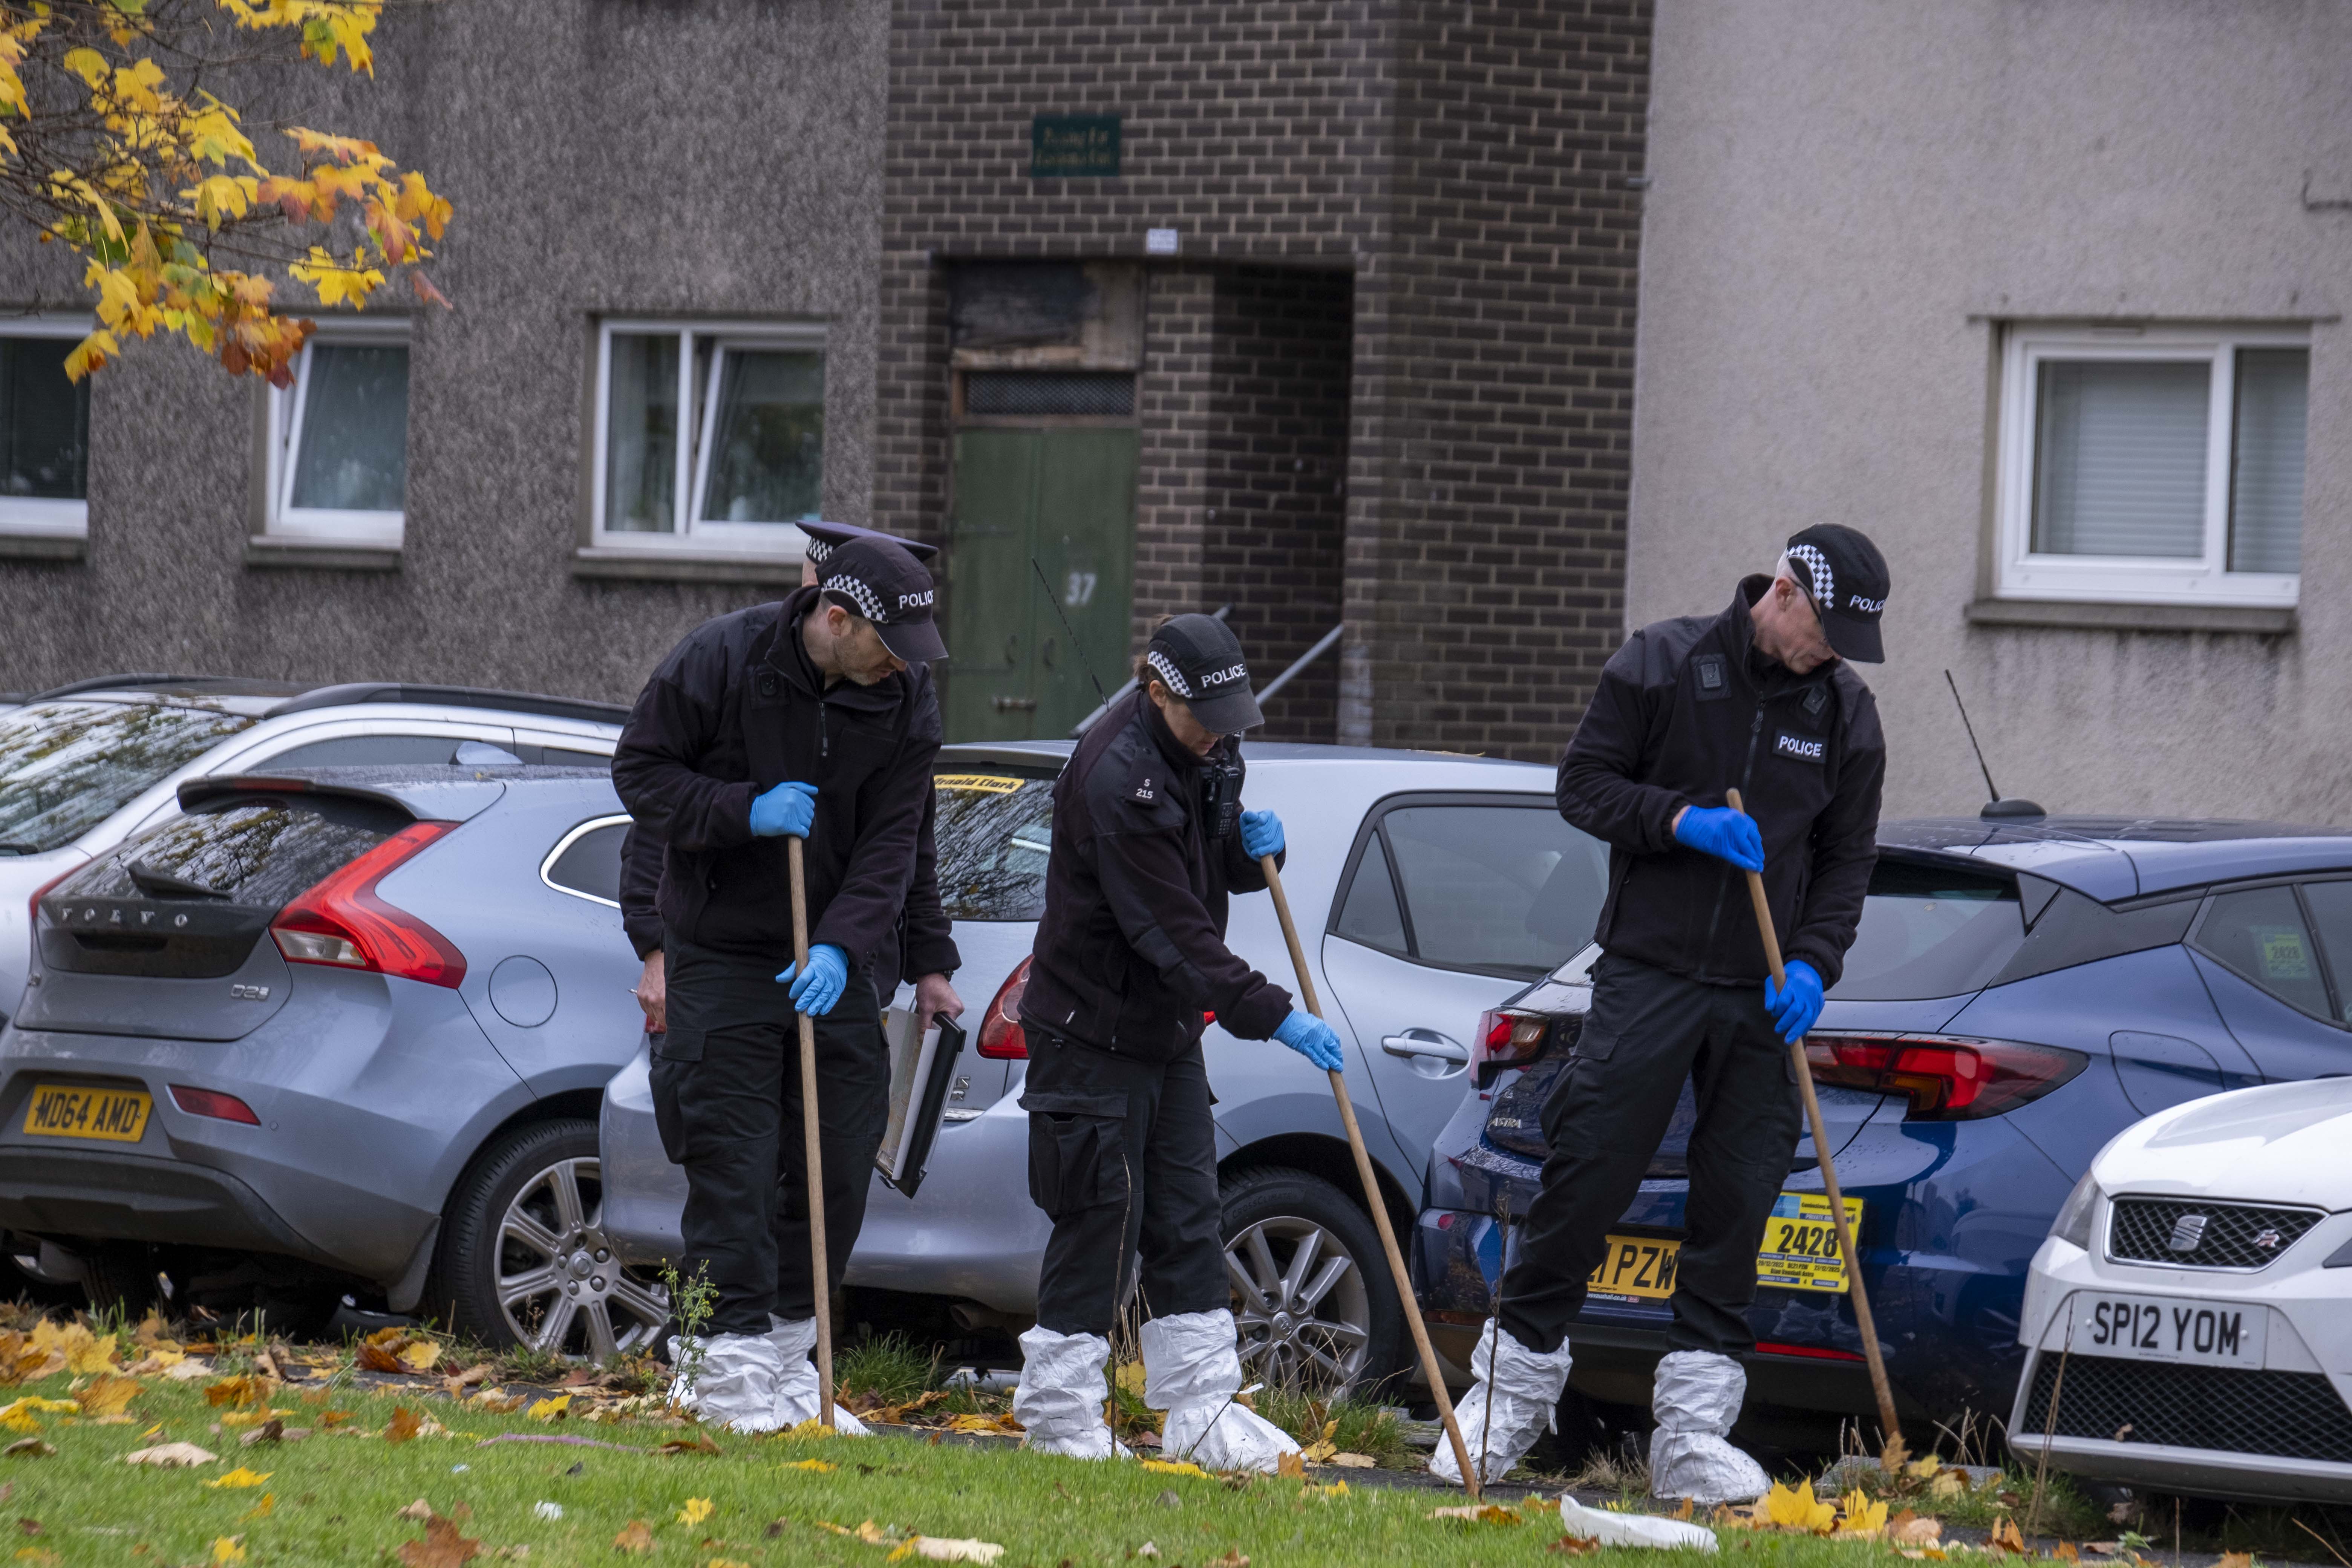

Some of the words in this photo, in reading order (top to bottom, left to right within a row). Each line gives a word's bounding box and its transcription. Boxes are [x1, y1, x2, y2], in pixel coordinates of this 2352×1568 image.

[1849, 594, 1886, 613] POLIC
[1201, 663, 1246, 688] POLICE
[1778, 735, 1822, 758] POLICE
[977, 778, 1017, 789] Clark
[1136, 788, 1153, 799] 215
[1144, 778, 1151, 787] S
[62, 907, 188, 928] VOLVO
[35, 1091, 92, 1130] MD64
[92, 1096, 141, 1134] AMD
[1488, 1117, 1522, 1129] ASTRA
[1777, 1224, 1839, 1257] 2428
[1612, 1244, 1679, 1290] PZW
[2093, 1301, 2161, 1349] SP12
[2173, 1307, 2242, 1356] YOM
